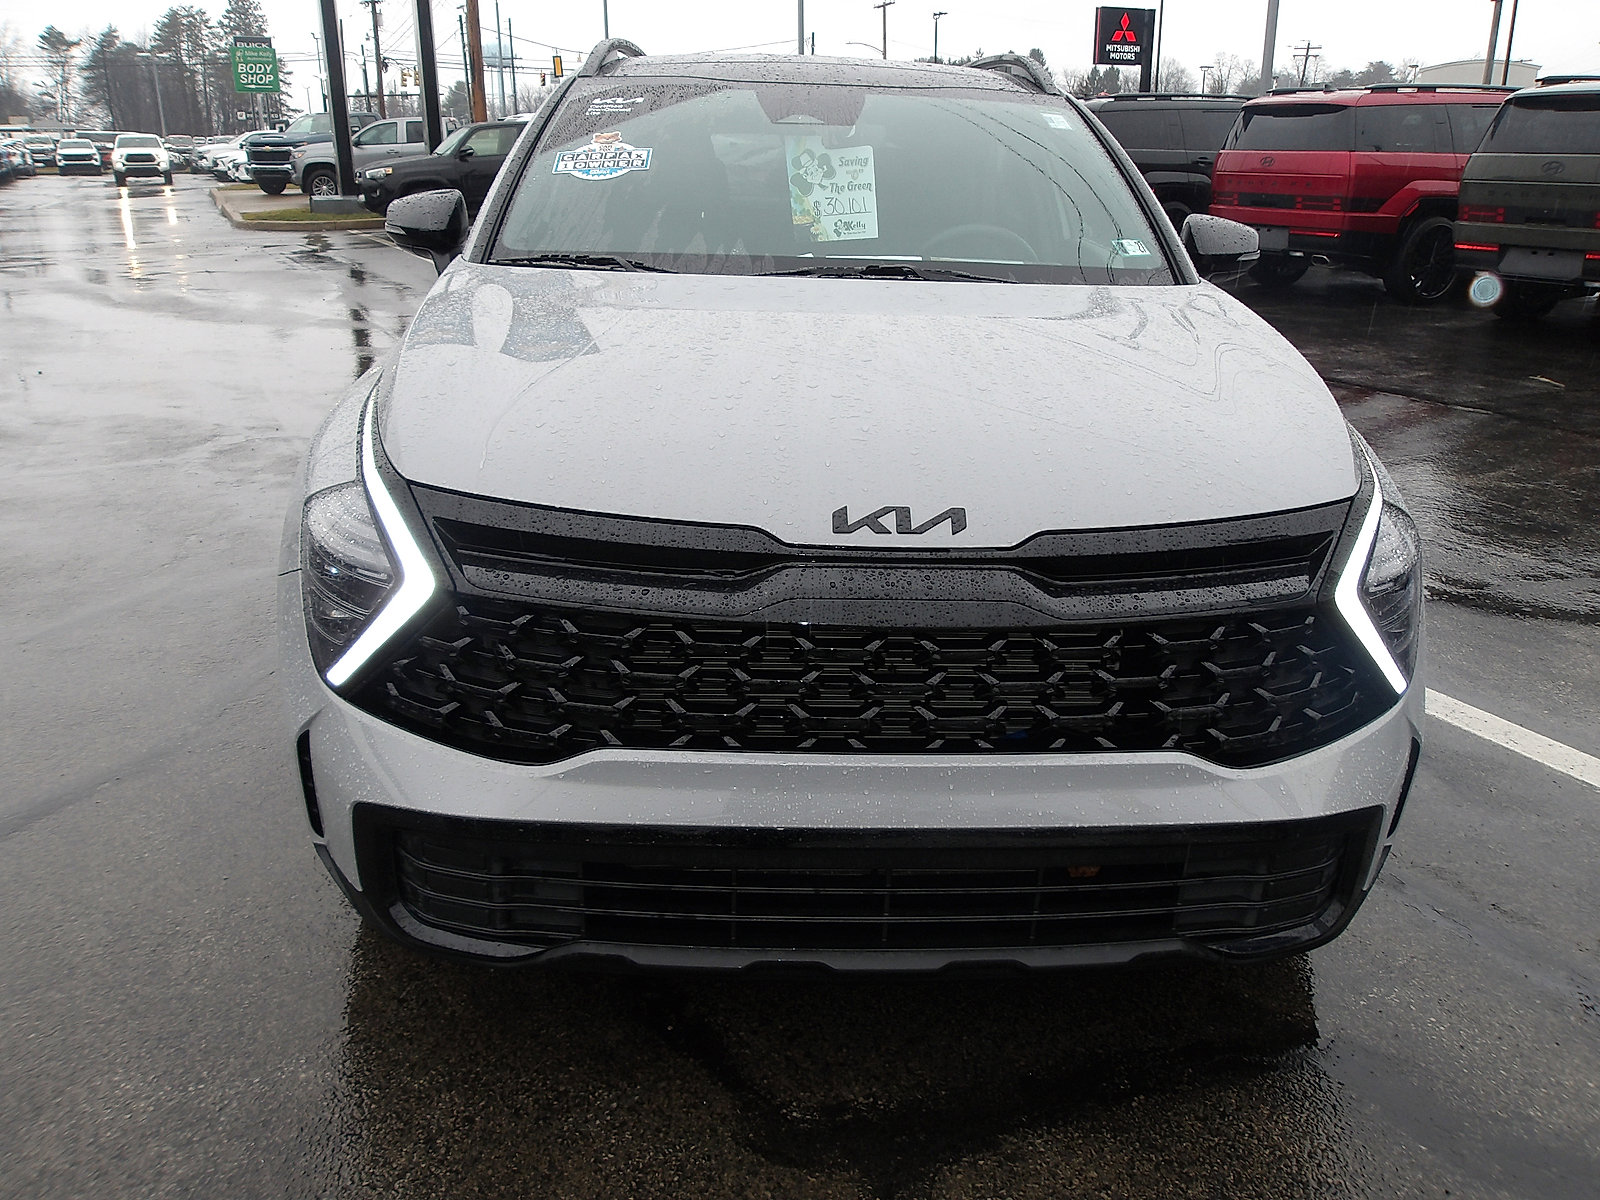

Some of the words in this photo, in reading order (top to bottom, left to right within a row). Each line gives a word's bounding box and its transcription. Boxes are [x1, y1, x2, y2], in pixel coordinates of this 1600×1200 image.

[236, 41, 269, 49] BUICK
[1106, 44, 1140, 53] MITSUBISHI
[238, 63, 273, 74] BODY
[240, 74, 274, 84] SHOP
[561, 151, 645, 162] CARFAX
[838, 156, 869, 168] Saving
[573, 159, 646, 170] OWNER
[829, 182, 847, 195] The
[847, 180, 873, 193] Green
[832, 505, 967, 535] KIA
